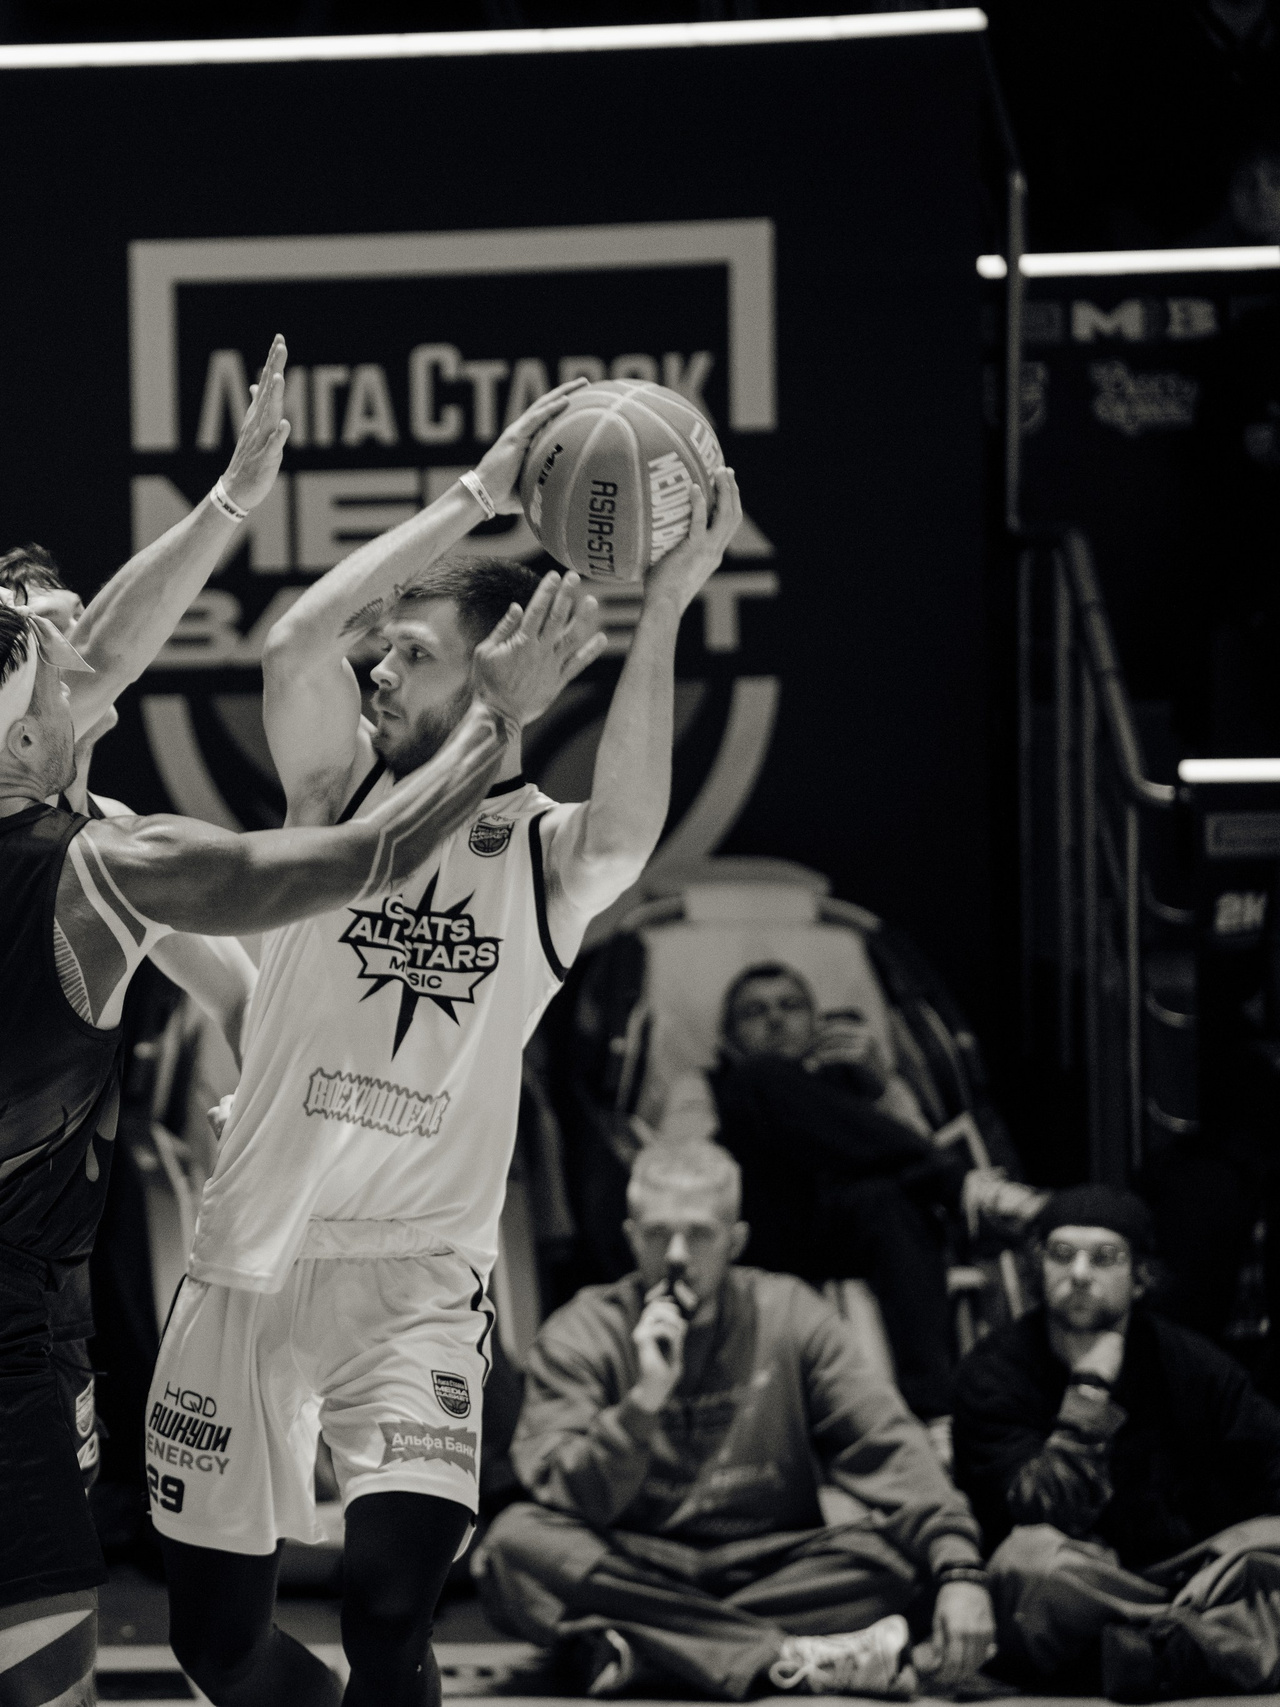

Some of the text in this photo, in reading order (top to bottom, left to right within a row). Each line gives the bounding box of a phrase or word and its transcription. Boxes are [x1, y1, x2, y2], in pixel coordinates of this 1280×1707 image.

[389, 955, 443, 989] MSIC
[163, 1381, 217, 1418] HQD
[147, 1432, 230, 1475] ENERGY
[391, 1432, 443, 1452] Альфа
